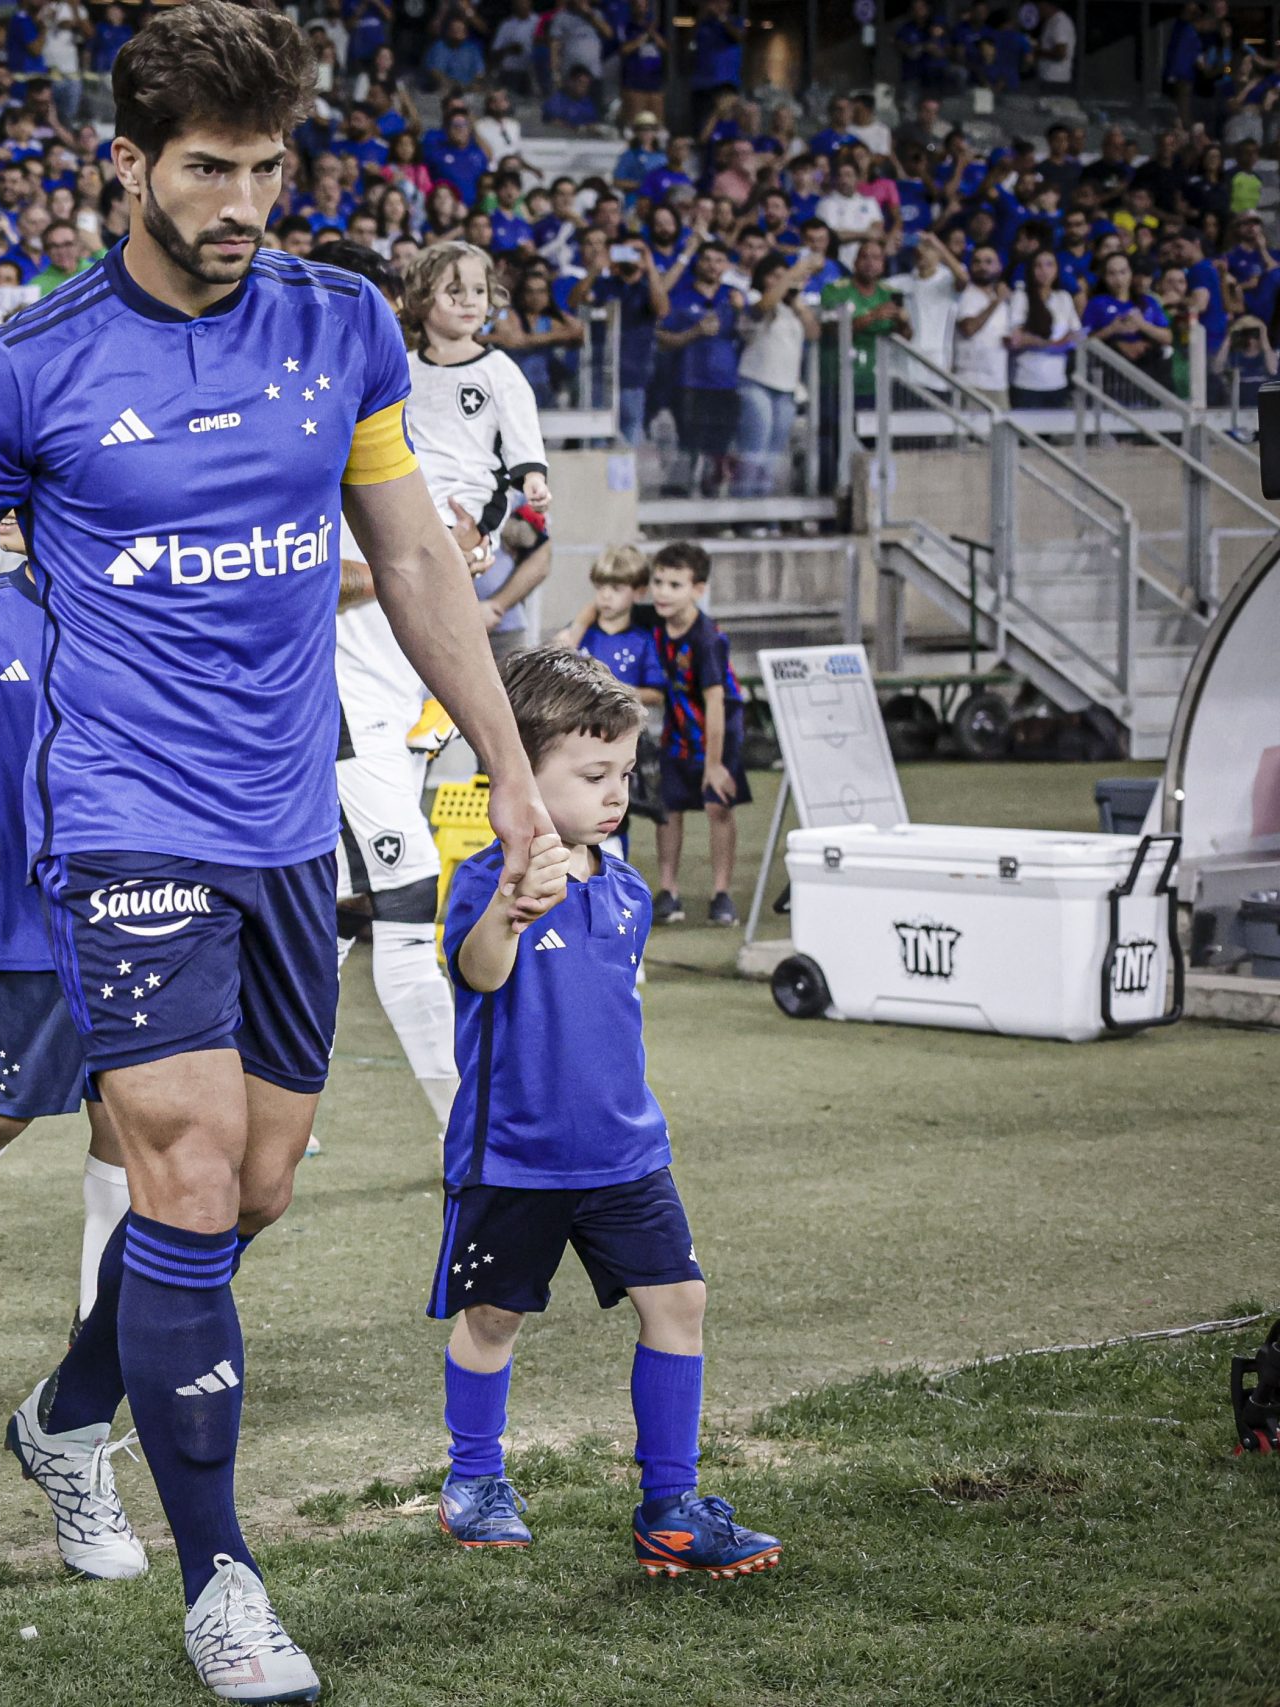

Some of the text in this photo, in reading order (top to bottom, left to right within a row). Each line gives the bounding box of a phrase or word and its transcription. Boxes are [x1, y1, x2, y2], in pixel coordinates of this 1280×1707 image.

[188, 412, 242, 433] CIMED
[168, 515, 333, 585] betfair
[88, 882, 212, 924] Saudali
[895, 924, 960, 977] TNT
[1114, 943, 1157, 992] TNT
